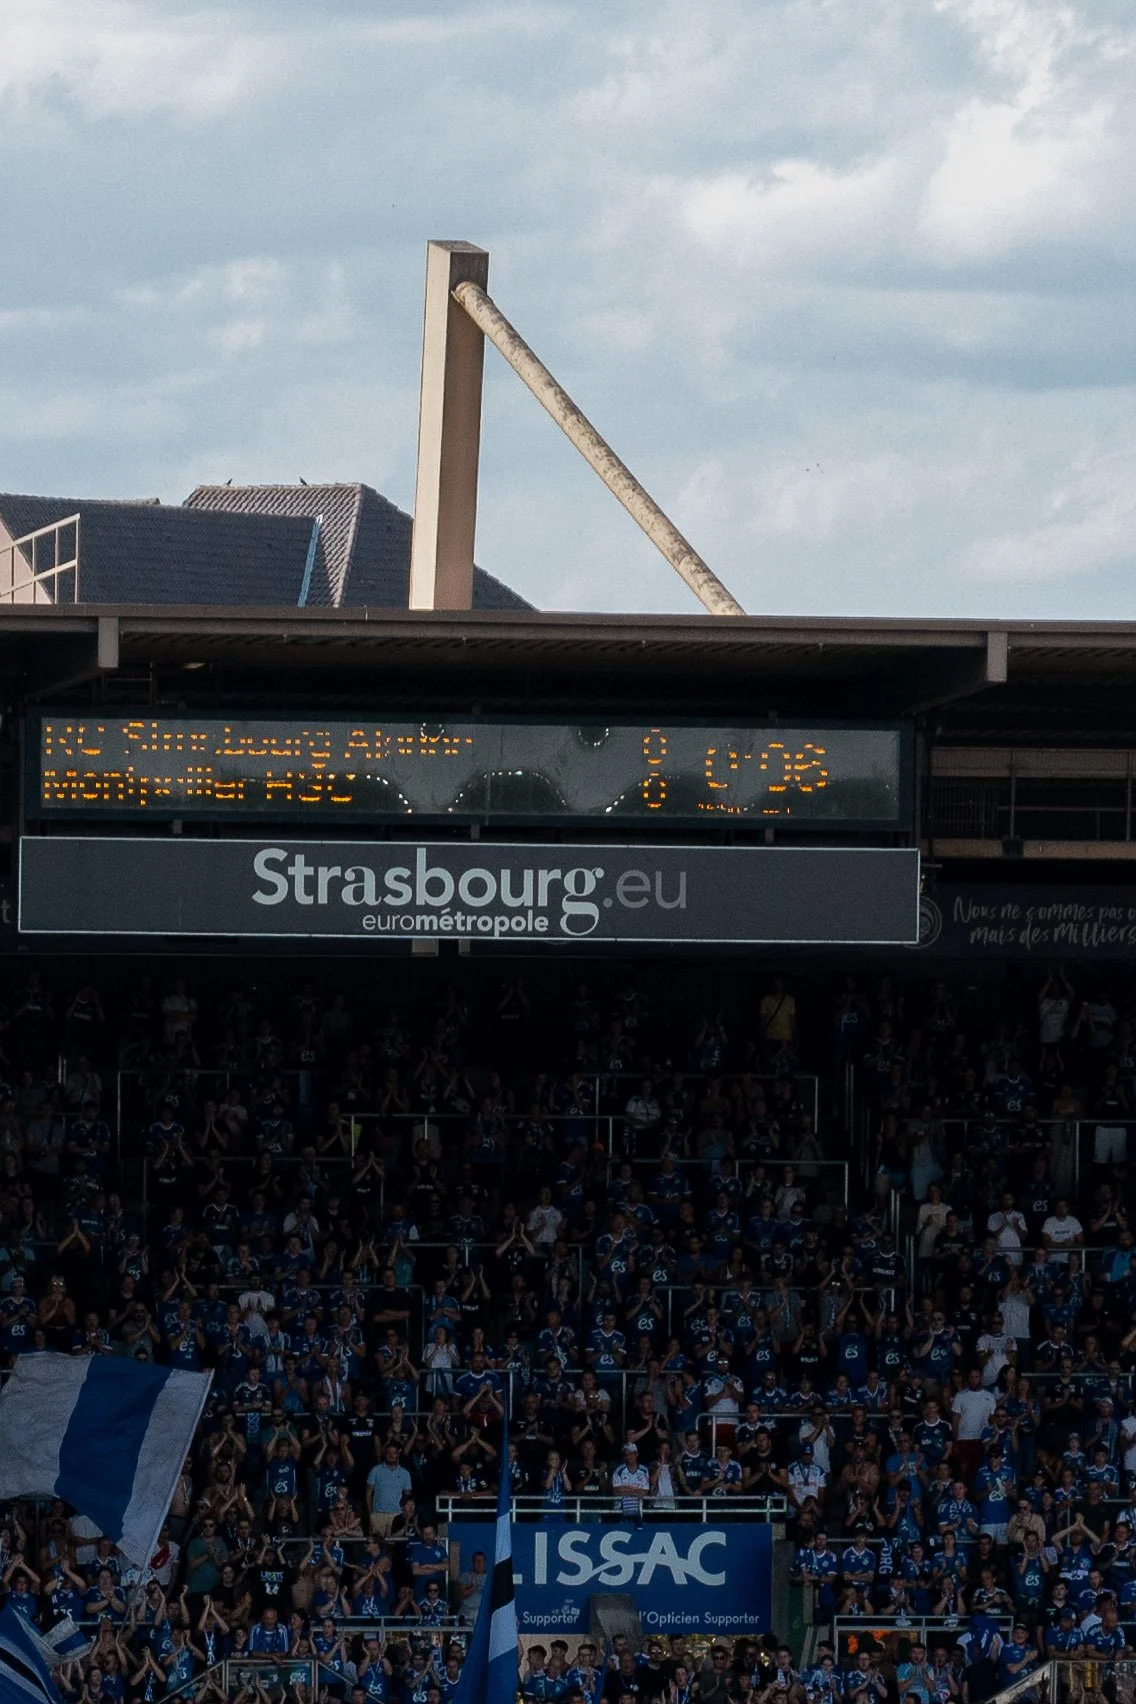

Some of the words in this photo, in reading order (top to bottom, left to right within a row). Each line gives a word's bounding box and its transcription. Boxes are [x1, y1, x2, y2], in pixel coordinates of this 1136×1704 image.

[252, 847, 688, 936] Strasbourg.eu
[361, 907, 550, 936] eurométropole
[513, 1530, 727, 1586] ISSAC
[638, 1611, 700, 1628] l'Opticien
[704, 1611, 760, 1628] Supporter
